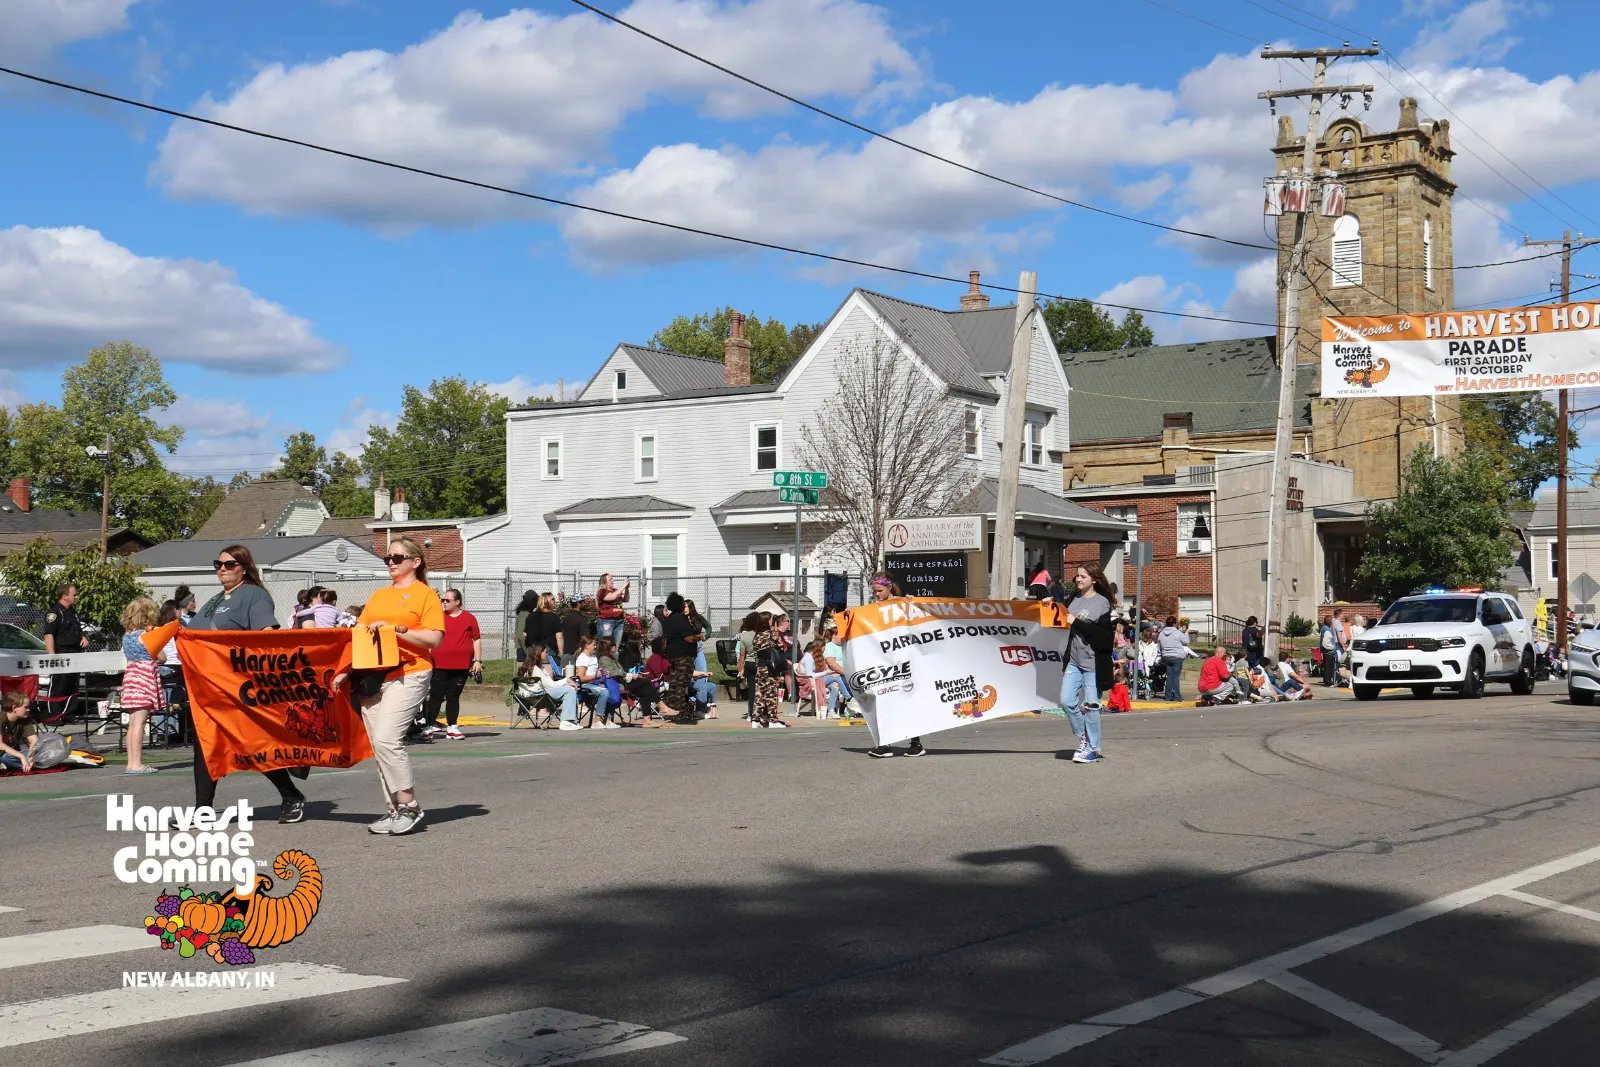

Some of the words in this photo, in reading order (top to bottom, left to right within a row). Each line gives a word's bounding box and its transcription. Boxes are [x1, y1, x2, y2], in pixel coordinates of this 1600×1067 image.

[1333, 322, 1394, 340] Welcome
[1398, 318, 1412, 331] to
[1425, 310, 1541, 338] HARVEST
[1551, 305, 1600, 330] HO
[1333, 344, 1372, 354] Harvest
[1448, 337, 1527, 356] PARADE
[1335, 358, 1373, 369] Coming
[1444, 357, 1472, 366] FIRST
[1474, 354, 1533, 365] SATURDAY
[1455, 366, 1467, 375] IN
[1469, 365, 1524, 375] OCTOBER
[1455, 371, 1600, 391] HARVESTHOMECO
[789, 473, 802, 485] 8th
[804, 473, 813, 486] St
[926, 522, 952, 531] MARY
[954, 522, 962, 530] of
[963, 521, 975, 529] the
[911, 530, 974, 539] ANNUNCIATION
[911, 540, 947, 548] CATHOLIC
[949, 538, 974, 546] PARISH
[887, 560, 911, 569] Misa
[926, 558, 963, 568] español
[906, 573, 945, 583] domingo
[916, 588, 934, 596] 12m
[878, 601, 959, 625] THANK
[959, 602, 1014, 616] YOU
[1050, 602, 1063, 627] 2
[879, 628, 945, 653] PARADE
[948, 625, 1028, 639] SPONSORS
[372, 628, 383, 665] 1
[229, 647, 311, 673] Harvest
[1001, 646, 1062, 663] usba
[39, 659, 71, 669] STREET
[252, 666, 318, 688] Home
[856, 660, 911, 686] COYLE
[934, 674, 975, 691] Harvest
[947, 682, 977, 695] Home
[877, 684, 899, 696] GMC
[940, 689, 979, 703] Coming
[234, 751, 267, 765] NEW
